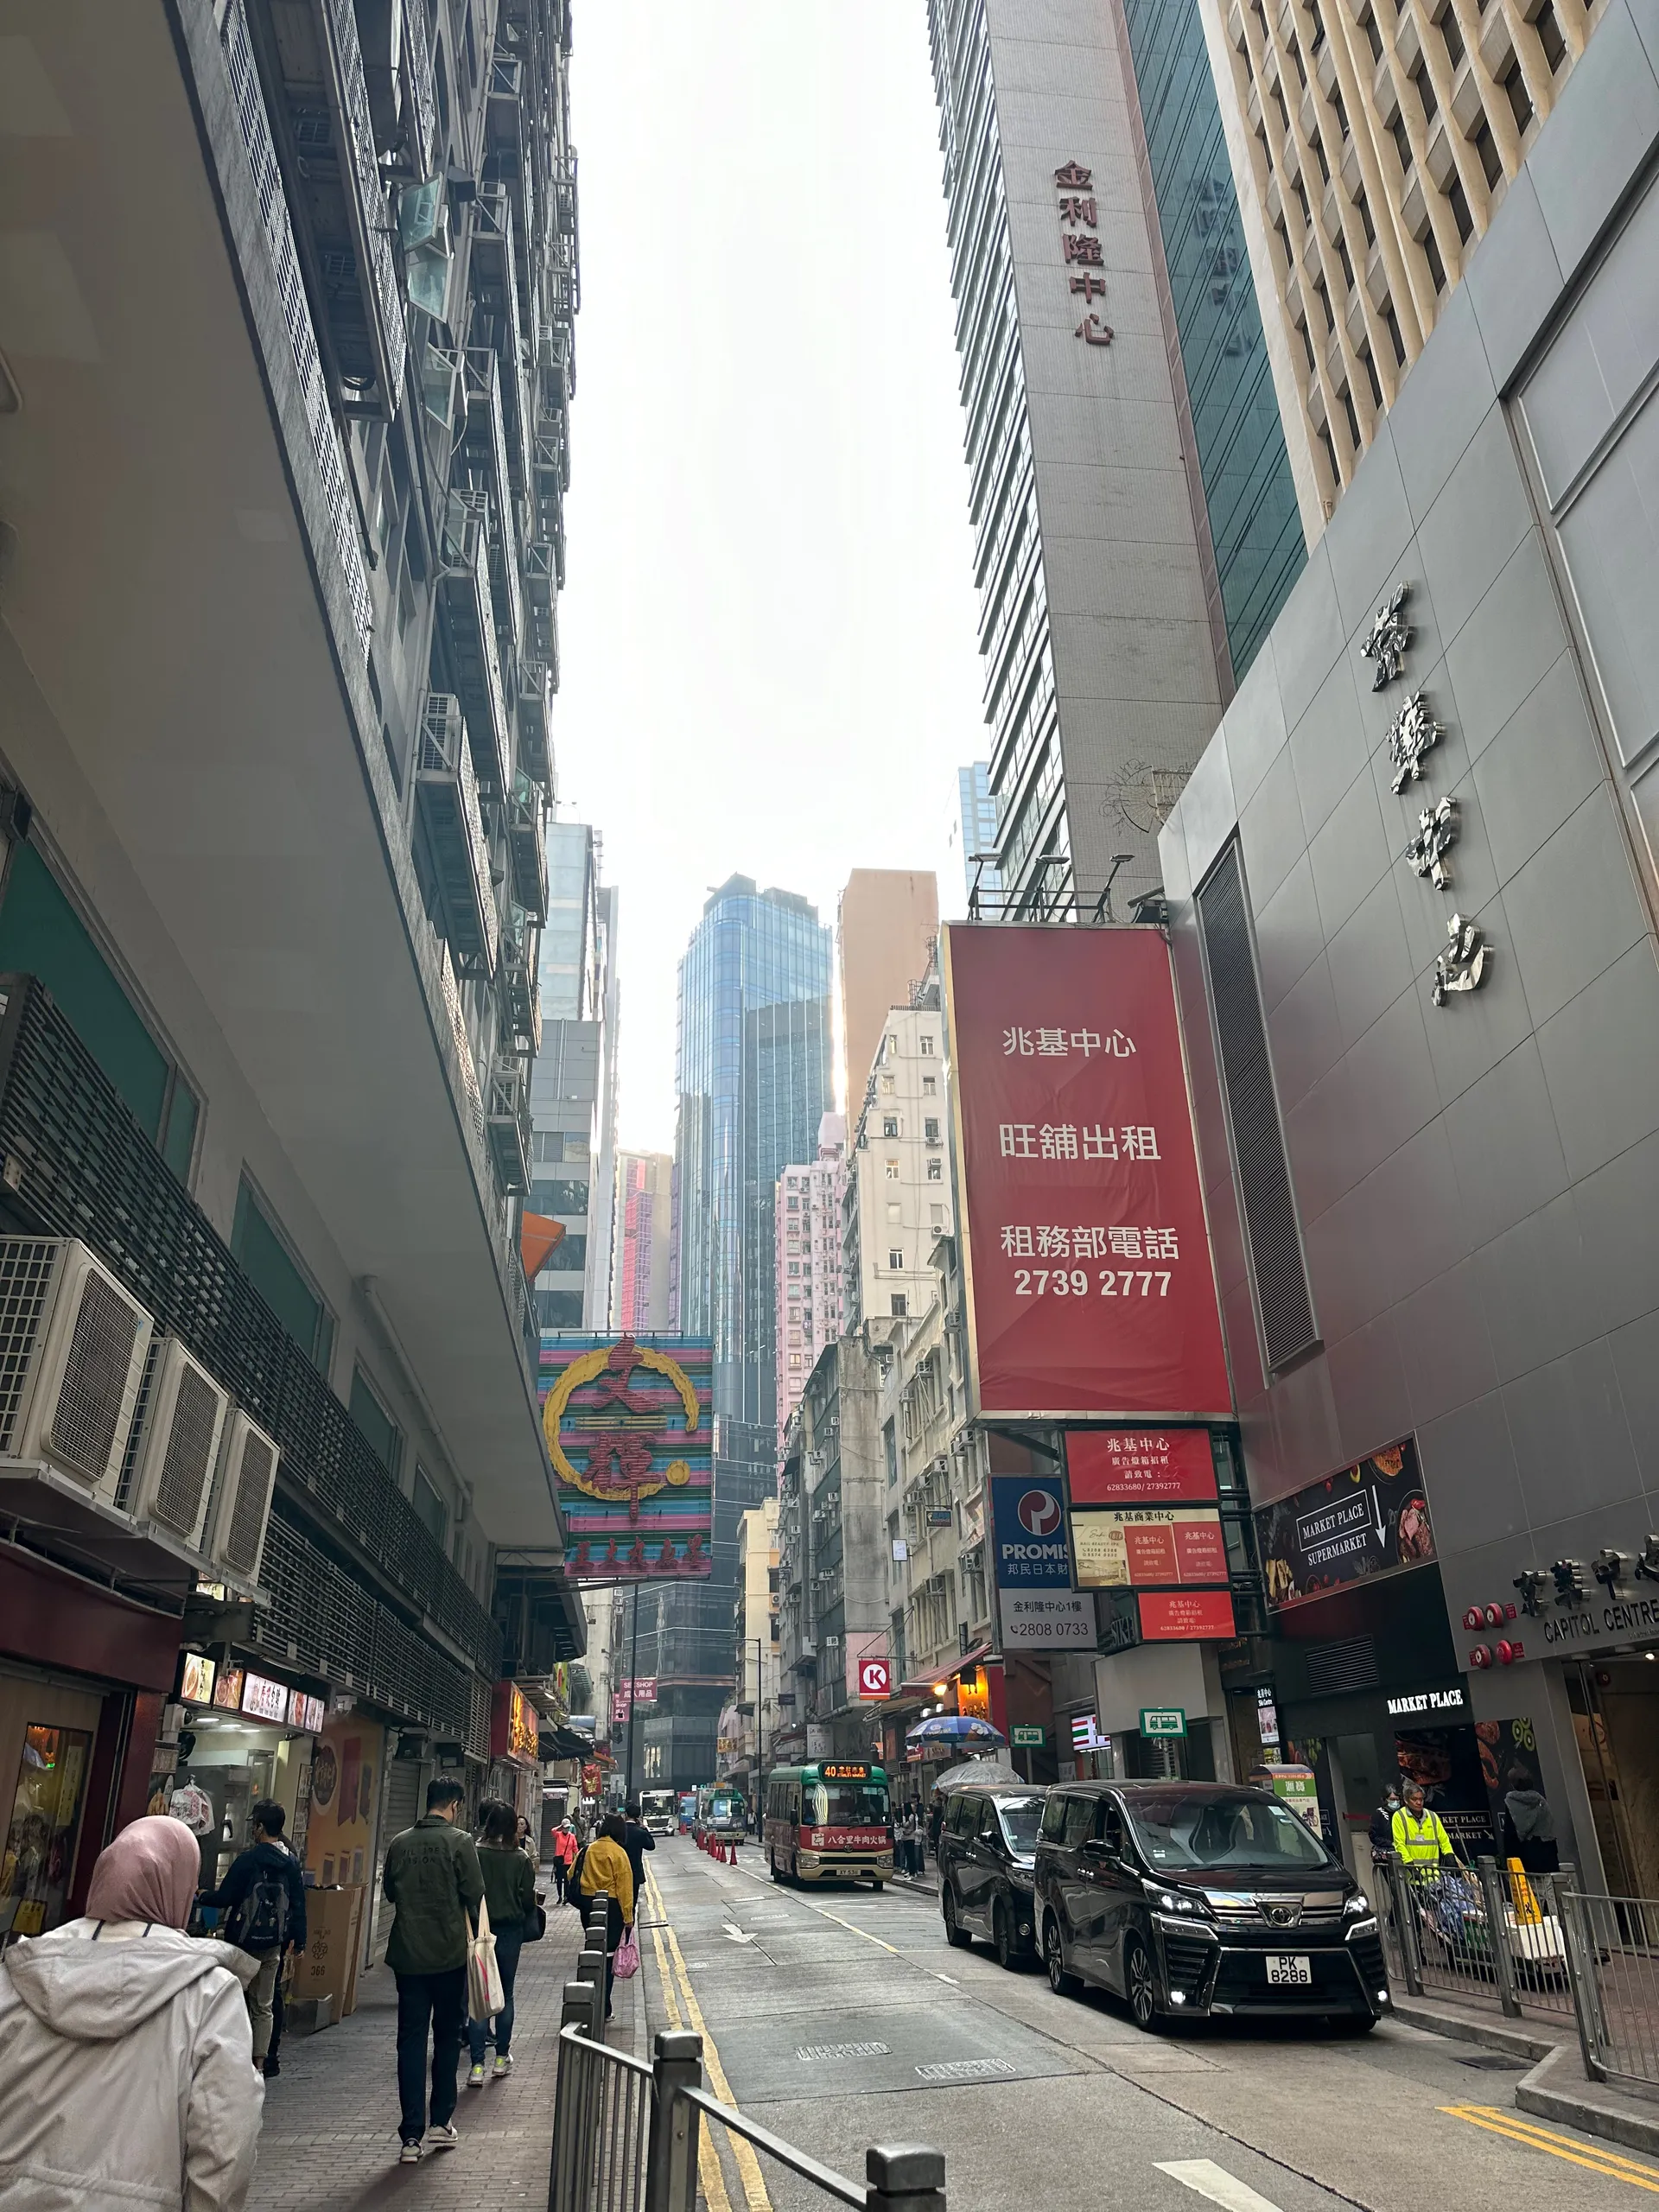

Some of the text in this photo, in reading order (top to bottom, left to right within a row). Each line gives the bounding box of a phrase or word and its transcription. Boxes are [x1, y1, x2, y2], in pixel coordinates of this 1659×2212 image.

[1054, 160, 1115, 345] 金利隆中心
[1002, 1027, 1137, 1058] 兆基中心
[999, 1123, 1161, 1160] 旺舖出租
[1001, 1224, 1179, 1260] 租務部電話
[1014, 1269, 1172, 1297] 2739 2777
[1107, 1437, 1170, 1452] 兆基中心
[1147, 1482, 1181, 1491] 27392777
[1114, 1511, 1175, 1522] 兆基商業中心
[1302, 1503, 1364, 1539] MARKET PLACE
[1307, 1533, 1367, 1566] SUPERMARKET
[1014, 1601, 1082, 1612] 金利隆中心1樓
[1020, 1623, 1088, 1636] 2808 0733
[1544, 1613, 1600, 1643] CAPITOL
[1604, 1599, 1659, 1631] CENTRE
[869, 1669, 885, 1688] K
[1387, 1689, 1463, 1714] MARKET PLACE
[824, 1766, 836, 1777] 40
[1442, 1815, 1459, 1824] KET
[1447, 1831, 1482, 1840] MARKET
[1279, 1956, 1297, 1969] PK
[1271, 1969, 1307, 1983] 8288
